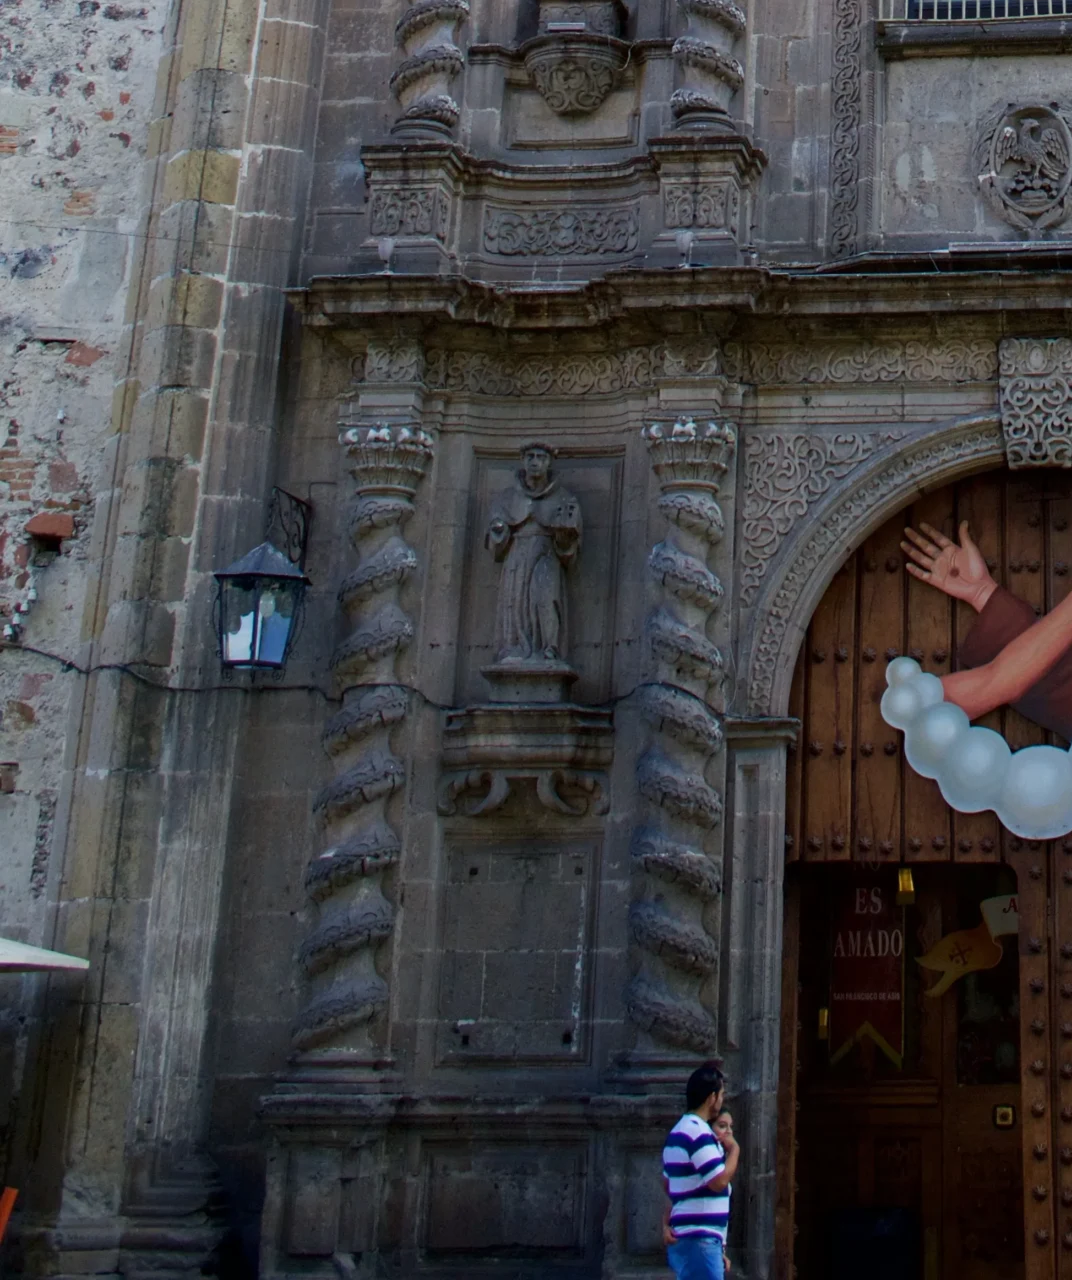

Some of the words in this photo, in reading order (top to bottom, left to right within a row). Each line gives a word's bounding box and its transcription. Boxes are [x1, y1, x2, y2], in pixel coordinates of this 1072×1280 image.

[855, 886, 883, 915] ES
[833, 928, 903, 958] AMADO
[833, 992, 845, 1001] SAN
